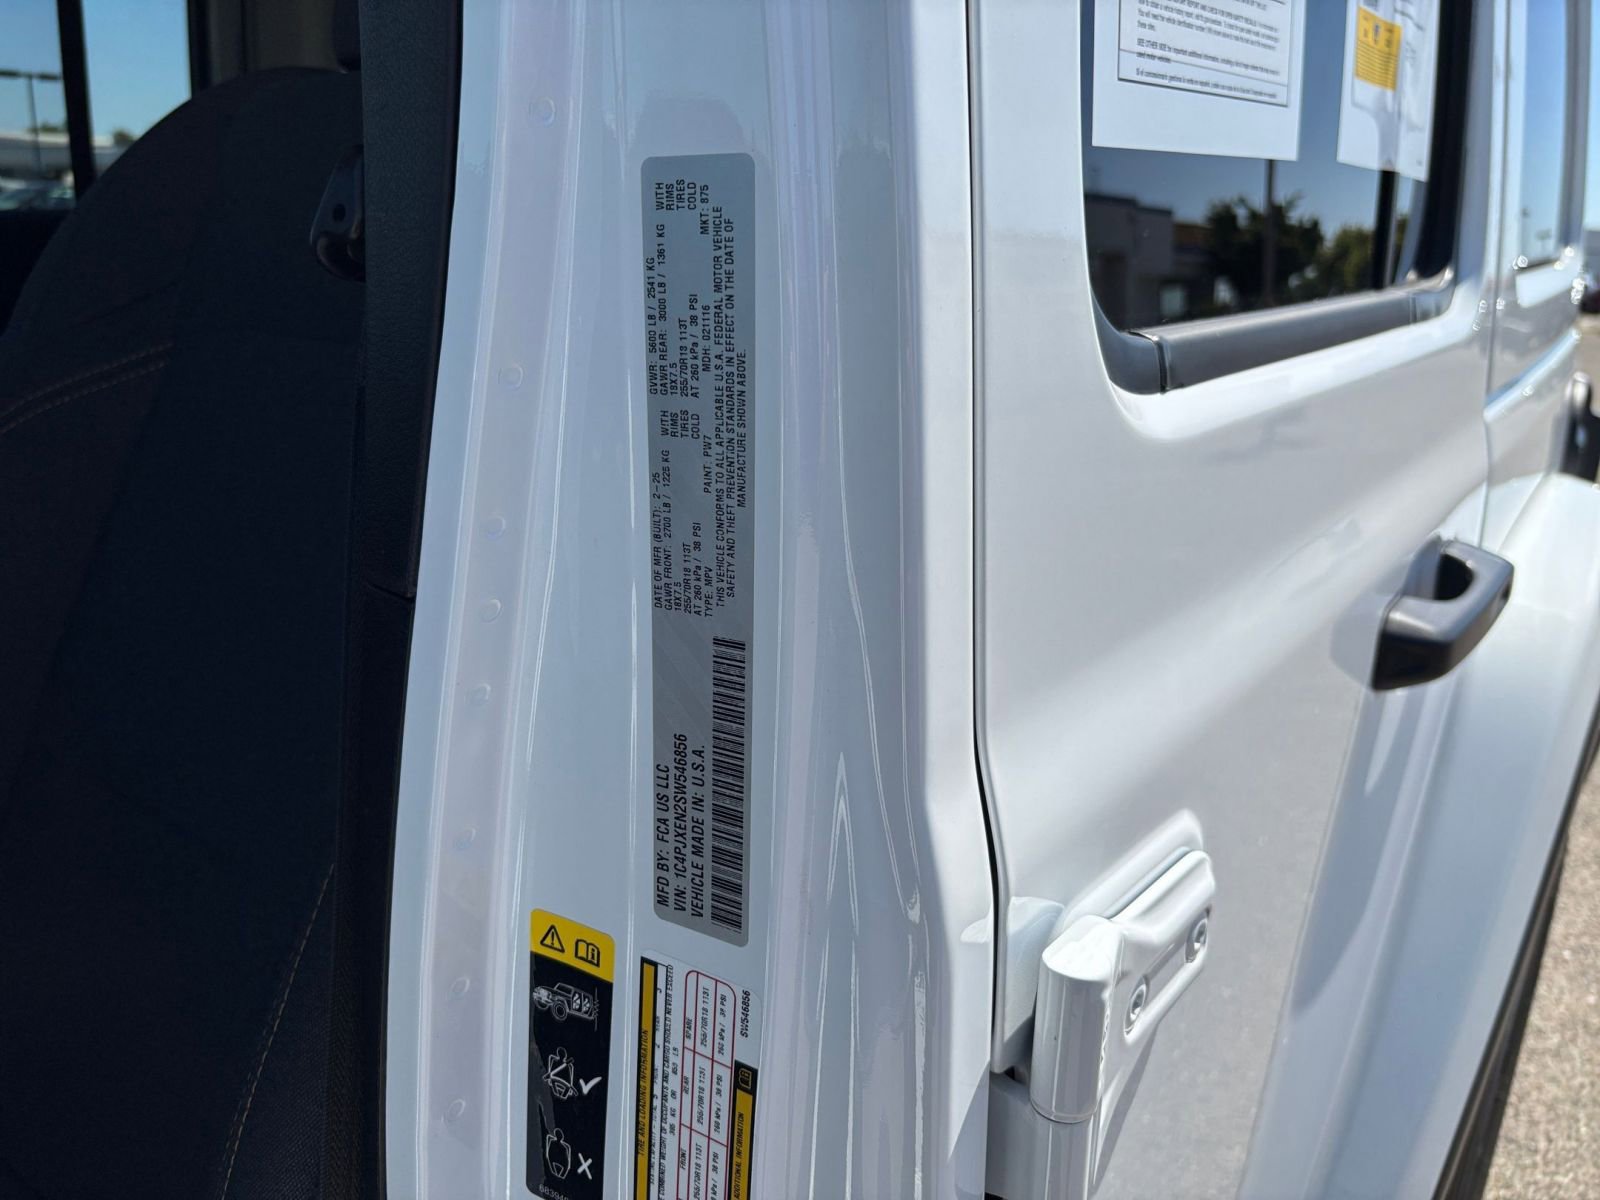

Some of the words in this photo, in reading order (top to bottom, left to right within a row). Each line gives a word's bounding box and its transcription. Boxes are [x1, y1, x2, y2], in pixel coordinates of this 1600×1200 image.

[656, 182, 664, 210] WITH
[666, 184, 674, 210] RIMS
[676, 179, 685, 210] TIRES
[687, 182, 696, 210] COLD
[700, 185, 708, 204] 875
[656, 224, 665, 237] KG
[700, 208, 709, 235] MKT:
[713, 206, 722, 251] VEHICLE
[724, 218, 733, 232] OF
[657, 243, 666, 265] 1361
[724, 236, 733, 264] DATE
[647, 257, 655, 271] KG
[714, 256, 722, 293] MOTOR
[647, 276, 656, 298] 2541
[658, 282, 666, 294] LB
[724, 269, 733, 289] THE
[658, 298, 667, 321] 3000
[689, 294, 697, 310] PSI
[725, 294, 733, 309] ON
[648, 315, 656, 326] LB
[679, 318, 687, 341] 113T
[690, 315, 698, 326] 38
[702, 305, 710, 341] 021116
[714, 298, 722, 345] FEDERAL
[725, 314, 733, 352] EFFECT
[648, 331, 657, 353] 5600
[659, 329, 667, 360] REAR:
[690, 342, 699, 360] kPa
[702, 345, 711, 372] MDH:
[715, 351, 723, 381] U.S.A.
[725, 357, 734, 367] IN
[737, 349, 746, 386] ABOVE.
[649, 361, 657, 394] GVWR:
[659, 365, 668, 395] GAWR
[690, 364, 698, 381] 260
[690, 385, 699, 398] AT
[726, 372, 734, 433] STANDARDS
[715, 386, 723, 447] APPLICABLE
[737, 391, 745, 428] SHOWN
[661, 411, 669, 436] WITH
[691, 414, 700, 439] COLD
[662, 450, 669, 463] KG
[703, 435, 712, 457] PW7
[715, 451, 723, 468] ALL
[726, 438, 735, 499] PREVENTION
[737, 433, 746, 508] MANUFACTURE
[662, 466, 670, 487] 1225
[704, 462, 712, 493] PAINT:
[716, 472, 724, 484] TO
[663, 502, 671, 513] LB
[716, 488, 724, 541] CONFORMS
[727, 505, 735, 534] THEFT
[653, 506, 662, 542] (BUILT):
[663, 517, 671, 538] 2700
[693, 541, 701, 552] 38
[727, 538, 735, 558] AND
[654, 569, 662, 581] OF
[664, 546, 672, 578] FRONT:
[693, 565, 701, 581] kPa
[716, 545, 724, 583] VEHICLE
[705, 566, 713, 586] MPV
[727, 562, 735, 597] SAFETY
[654, 585, 662, 608] DATE
[664, 582, 672, 610] GAWR
[683, 568, 691, 614] 255/70R18
[705, 591, 713, 617] TYPE:
[716, 587, 724, 607] THIS
[694, 604, 702, 616] AT
[656, 764, 668, 789] LLC
[692, 745, 704, 787] U.S.A.
[656, 793, 668, 812] US
[674, 734, 687, 879] 1C4PJXEN2SW546856
[692, 792, 704, 812] IN:
[657, 818, 669, 843] FCA
[691, 817, 704, 857] MADE
[656, 850, 669, 872] BY:
[657, 878, 669, 907] MFD
[674, 885, 686, 912] VIN:
[691, 863, 704, 917] VEHICLE
[740, 990, 750, 1037] SW546856
[640, 1030, 648, 1083] INFORMATION
[639, 1086, 647, 1119] LOADING
[736, 1113, 744, 1158] INFORMATION
[735, 1160, 743, 1199] ADDITIONAL
